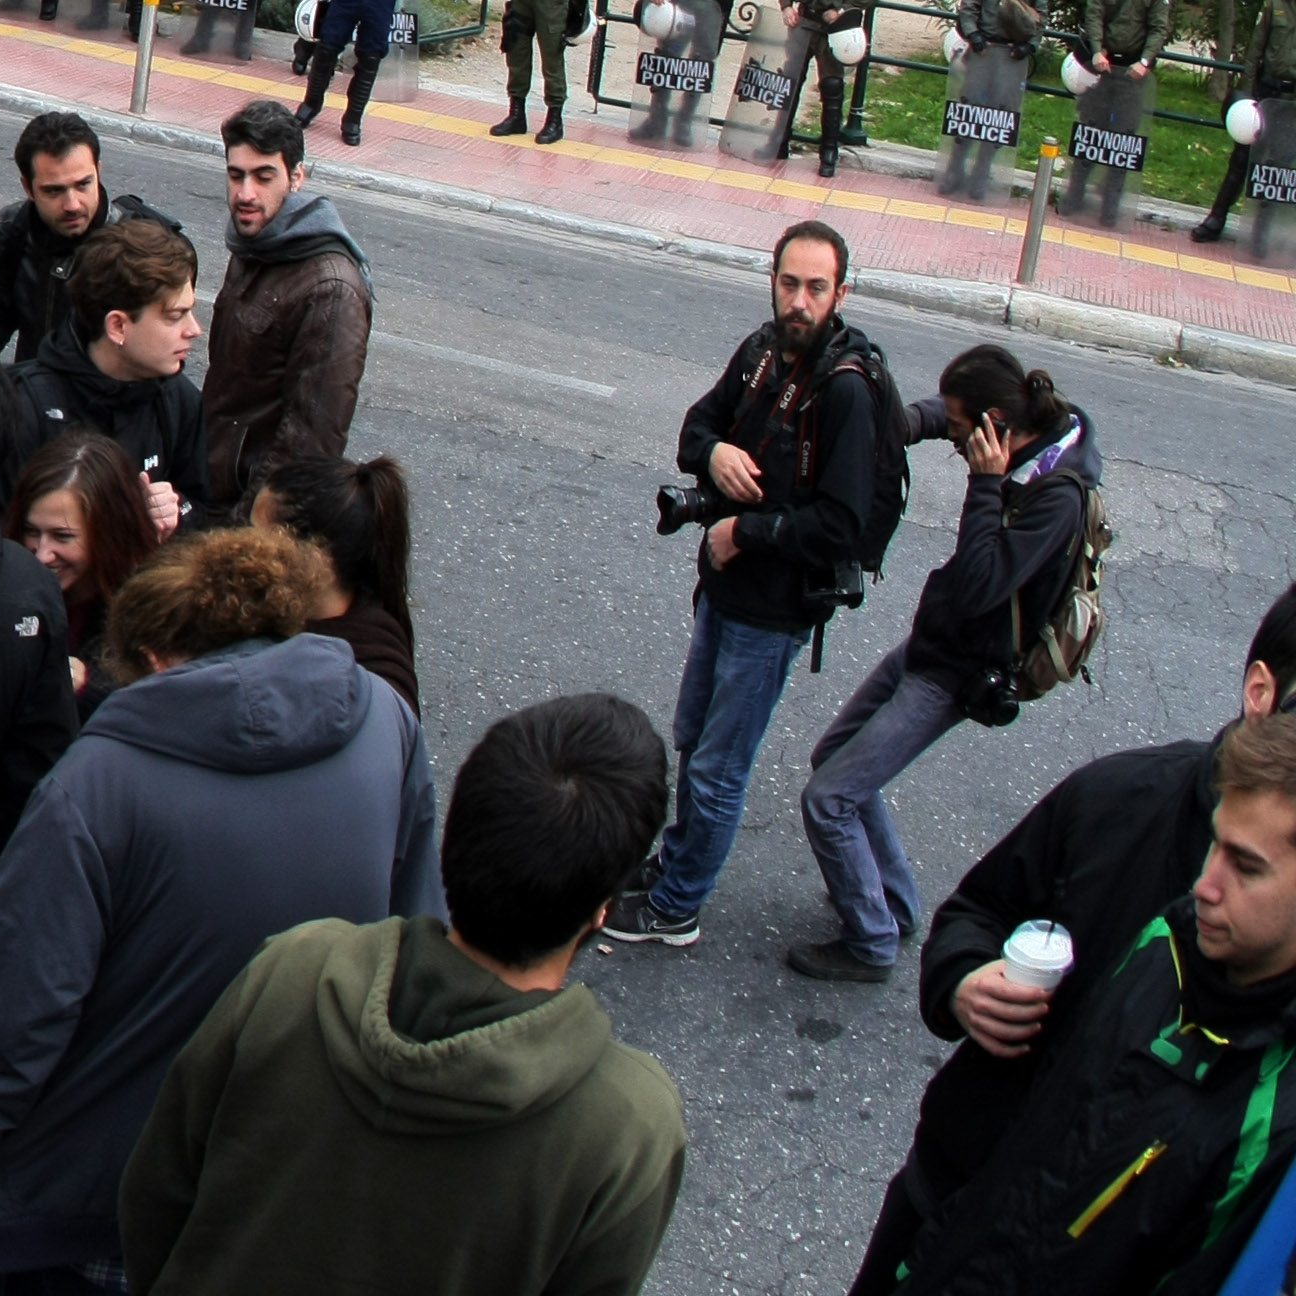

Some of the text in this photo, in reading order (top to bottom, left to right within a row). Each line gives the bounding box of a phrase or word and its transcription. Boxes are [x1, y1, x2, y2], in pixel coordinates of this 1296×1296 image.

[640, 54, 710, 79] ΑΣΤΥΝΟΜΙΑ
[641, 71, 706, 92] POLICE
[737, 81, 786, 109] POLICE
[946, 102, 1015, 130] ΑΣΤΥΝΟΜΙΑ
[947, 120, 1010, 144] POLICE
[1074, 124, 1143, 155] ΑΣΤΥΝΟΜΙΑ
[1074, 142, 1138, 169] POLICE
[751, 350, 772, 388] Canon
[780, 384, 796, 409] EOS
